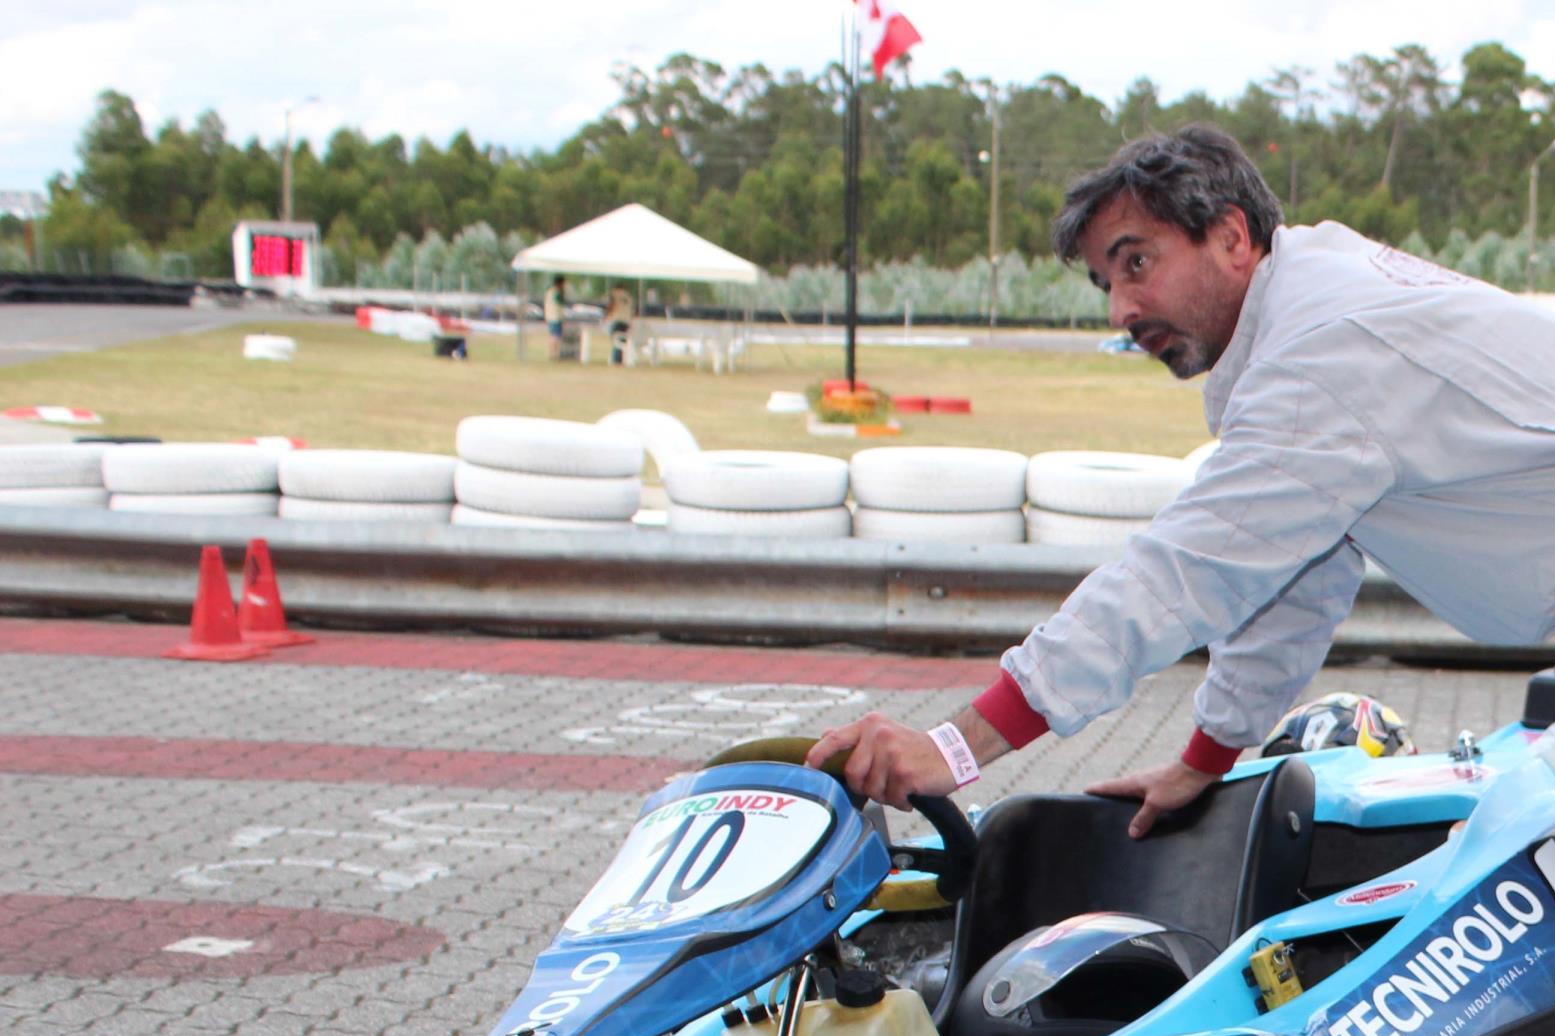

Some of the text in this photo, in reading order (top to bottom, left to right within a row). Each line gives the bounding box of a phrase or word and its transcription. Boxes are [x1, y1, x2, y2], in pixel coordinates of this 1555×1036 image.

[643, 795, 798, 828] EUROINDY
[628, 809, 746, 906] 10
[1464, 965, 1528, 1019] INDUSTRIAL,
[1524, 946, 1548, 966] S.A.
